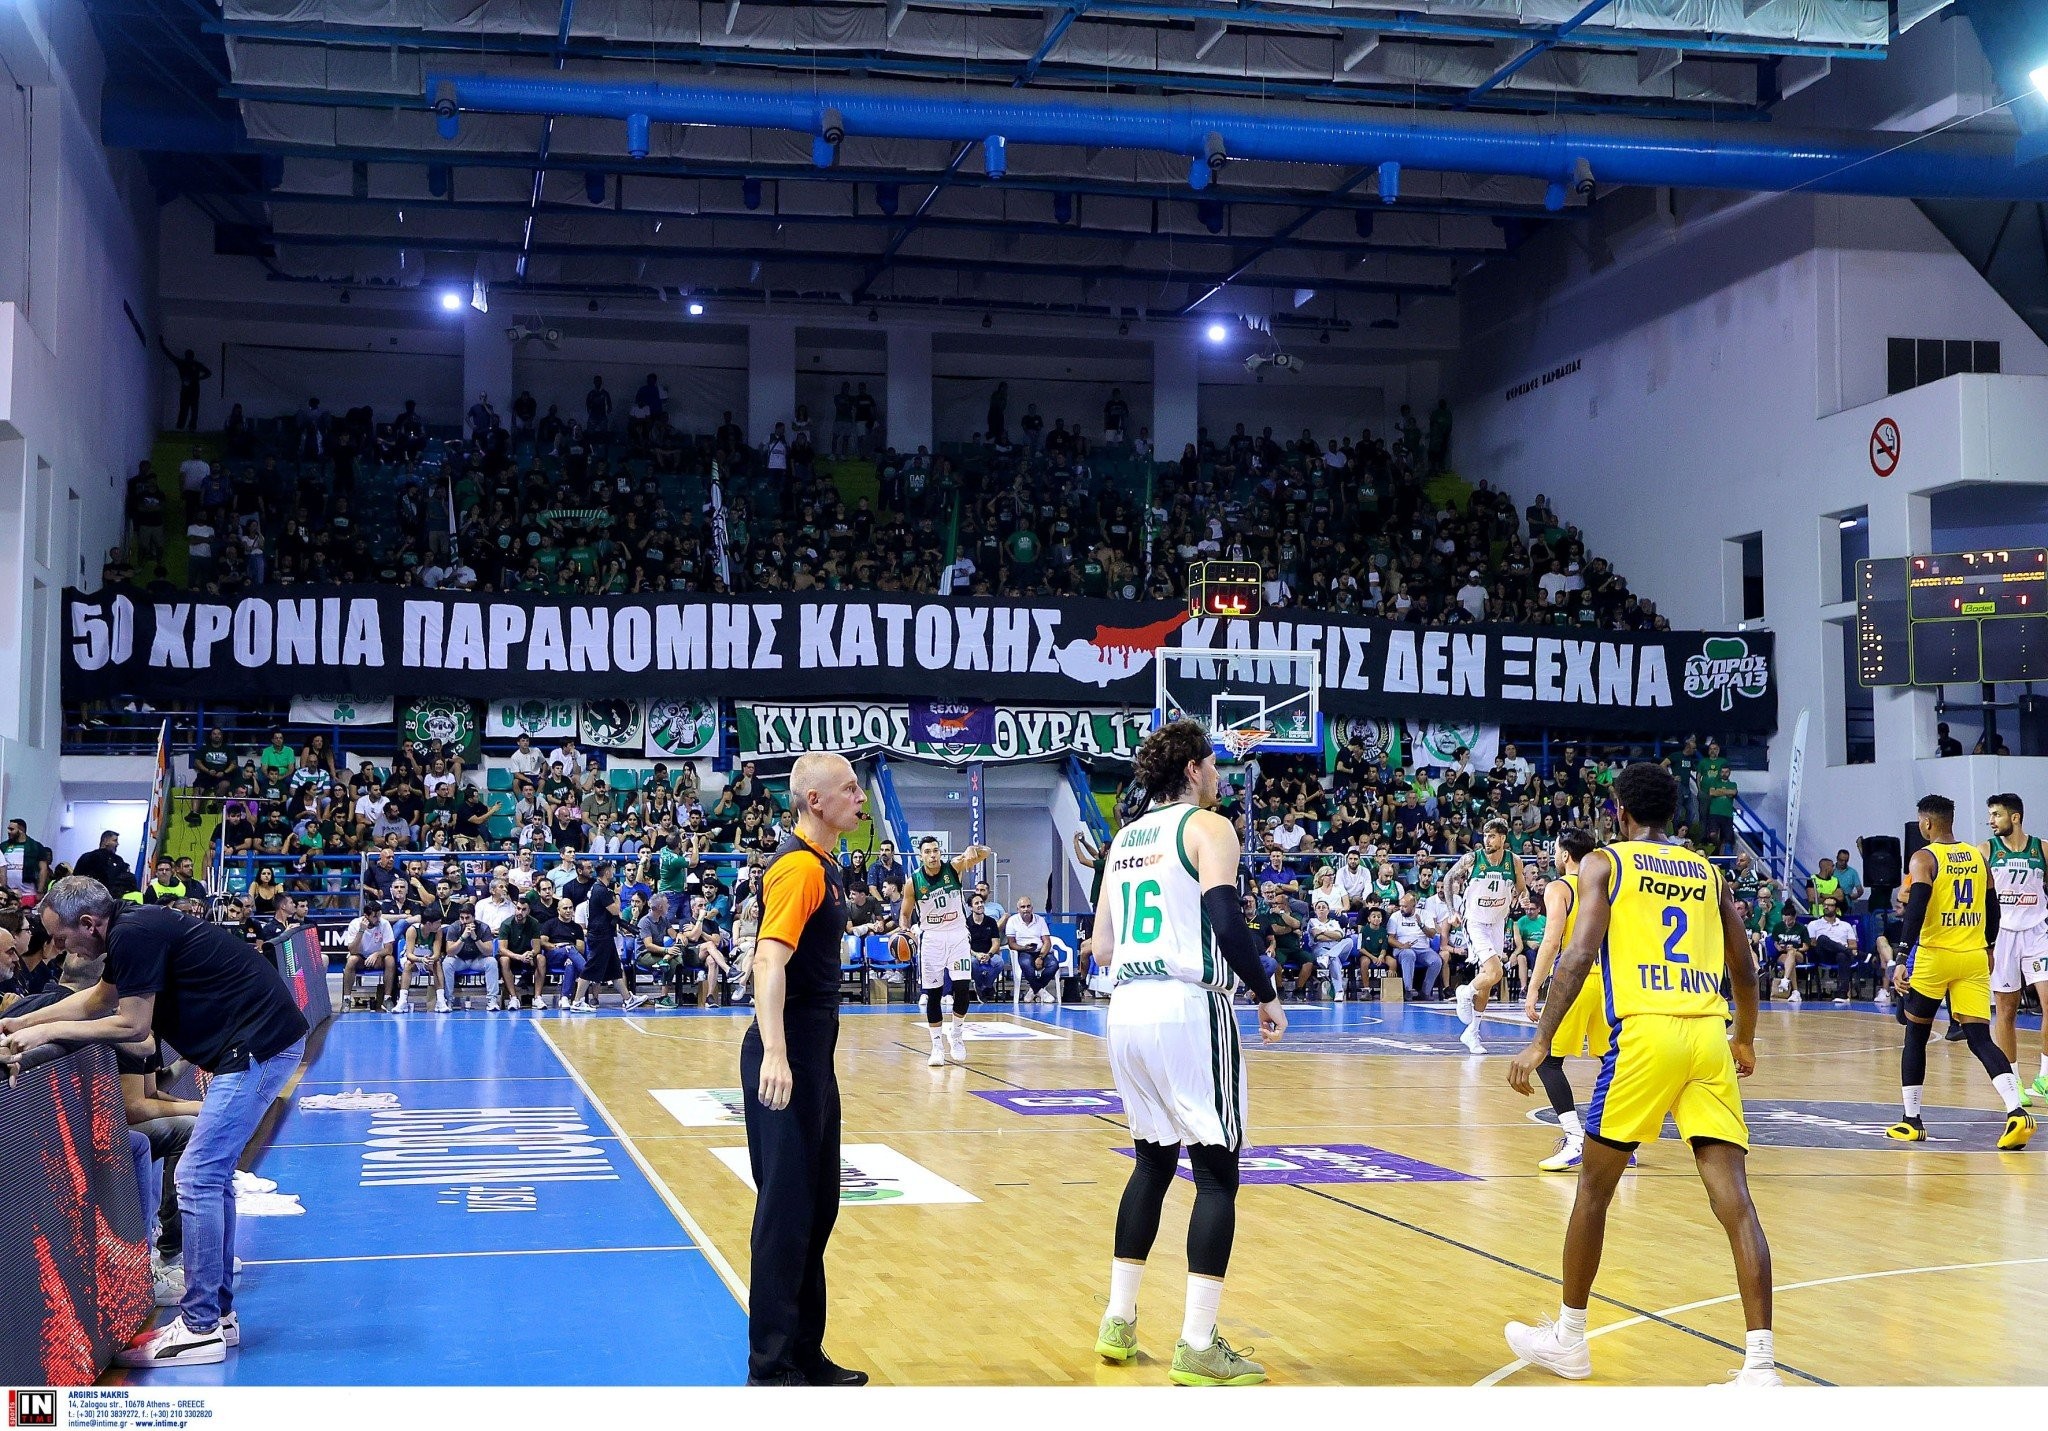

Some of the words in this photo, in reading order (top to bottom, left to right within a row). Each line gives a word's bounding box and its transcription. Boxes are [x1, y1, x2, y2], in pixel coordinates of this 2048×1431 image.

[71, 594, 135, 671] 50
[148, 597, 385, 669] ΧΡΟΝΙΑ
[402, 600, 783, 672] ΠΑΡΑΝΟΜΗΣ
[800, 603, 1062, 673] ΚΑΤΟΧΗΣ
[1180, 617, 1371, 690] ΚΑΝΕΙΣ
[1382, 629, 1487, 698] ΔΕΝ
[1501, 634, 1674, 706] ΞΕΧΝΑ
[1684, 655, 1767, 676] ΚΥΠΡΟΣ
[551, 704, 572, 727] 13
[754, 704, 916, 753] ΚΥΠΡΟΣ
[991, 710, 1100, 758] ΘΥΡΑ
[1121, 826, 1161, 848] OSMAN
[1633, 853, 1708, 880] SIMMONS
[1946, 864, 1978, 876] Rapyd
[2008, 869, 2028, 885] 77
[1487, 880, 1499, 893] 41
[1638, 876, 1707, 902] Rapyd
[1953, 878, 1974, 910] 14
[934, 896, 947, 909] 10
[1121, 879, 1163, 945] 16
[1941, 912, 1957, 927] TEL
[1661, 906, 1690, 963] 2
[960, 959, 971, 971] 10
[1638, 964, 1674, 991] TEL
[1681, 968, 1719, 994] AVIV
